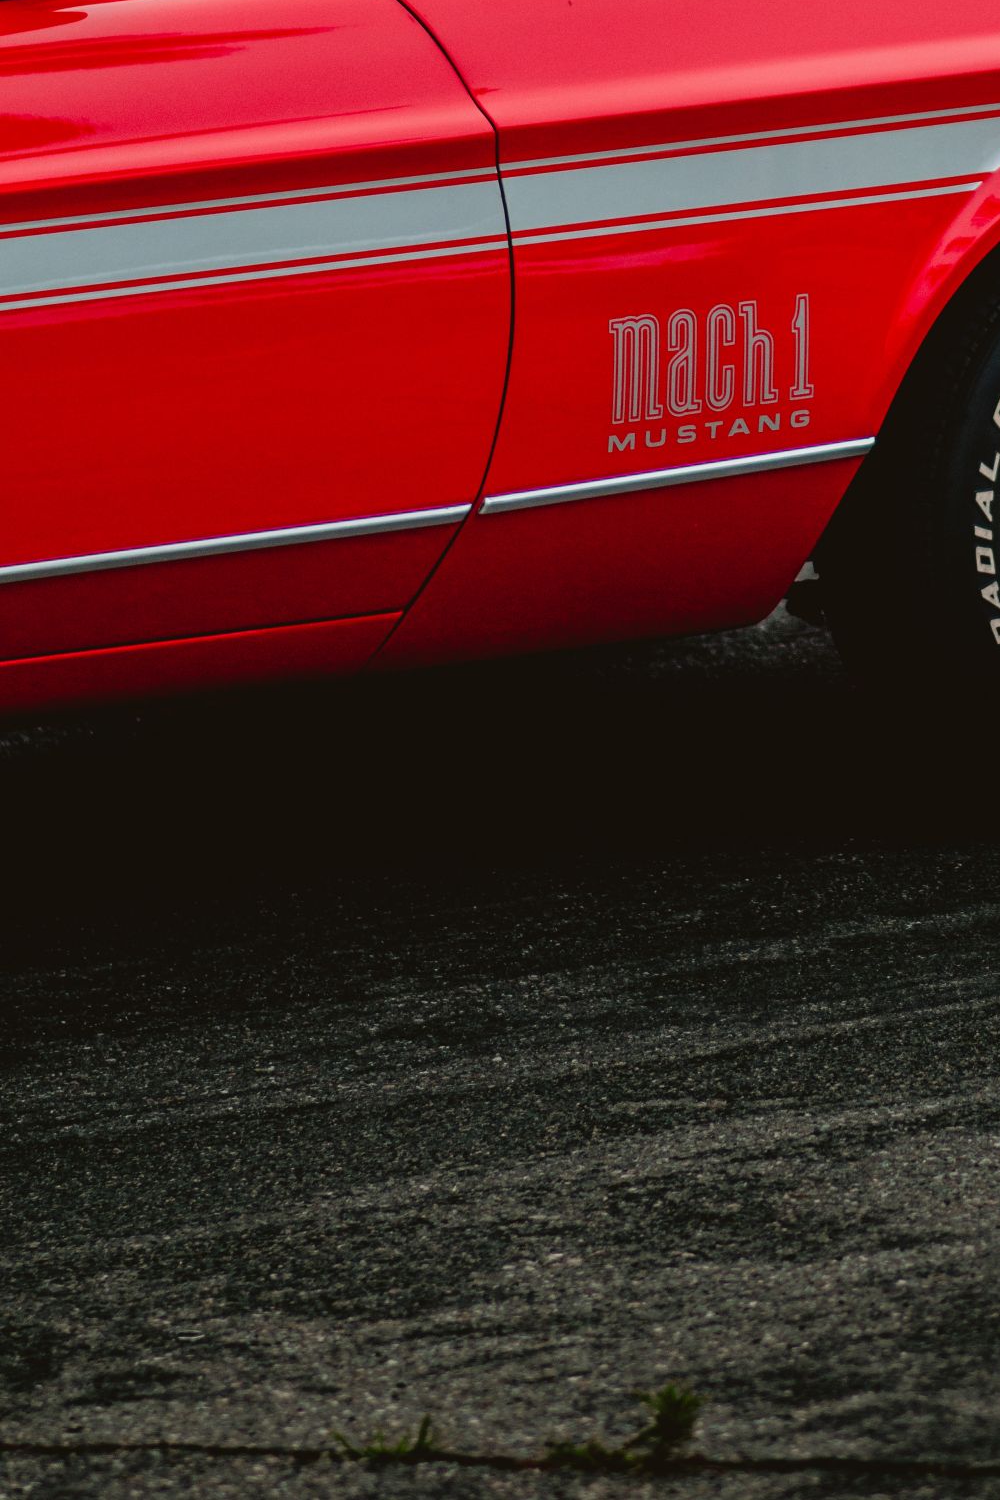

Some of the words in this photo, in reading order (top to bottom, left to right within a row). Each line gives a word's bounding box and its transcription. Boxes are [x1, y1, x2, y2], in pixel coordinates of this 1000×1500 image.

[609, 300, 779, 424] mach
[789, 293, 814, 400] 1
[607, 409, 811, 452] MUSTANG
